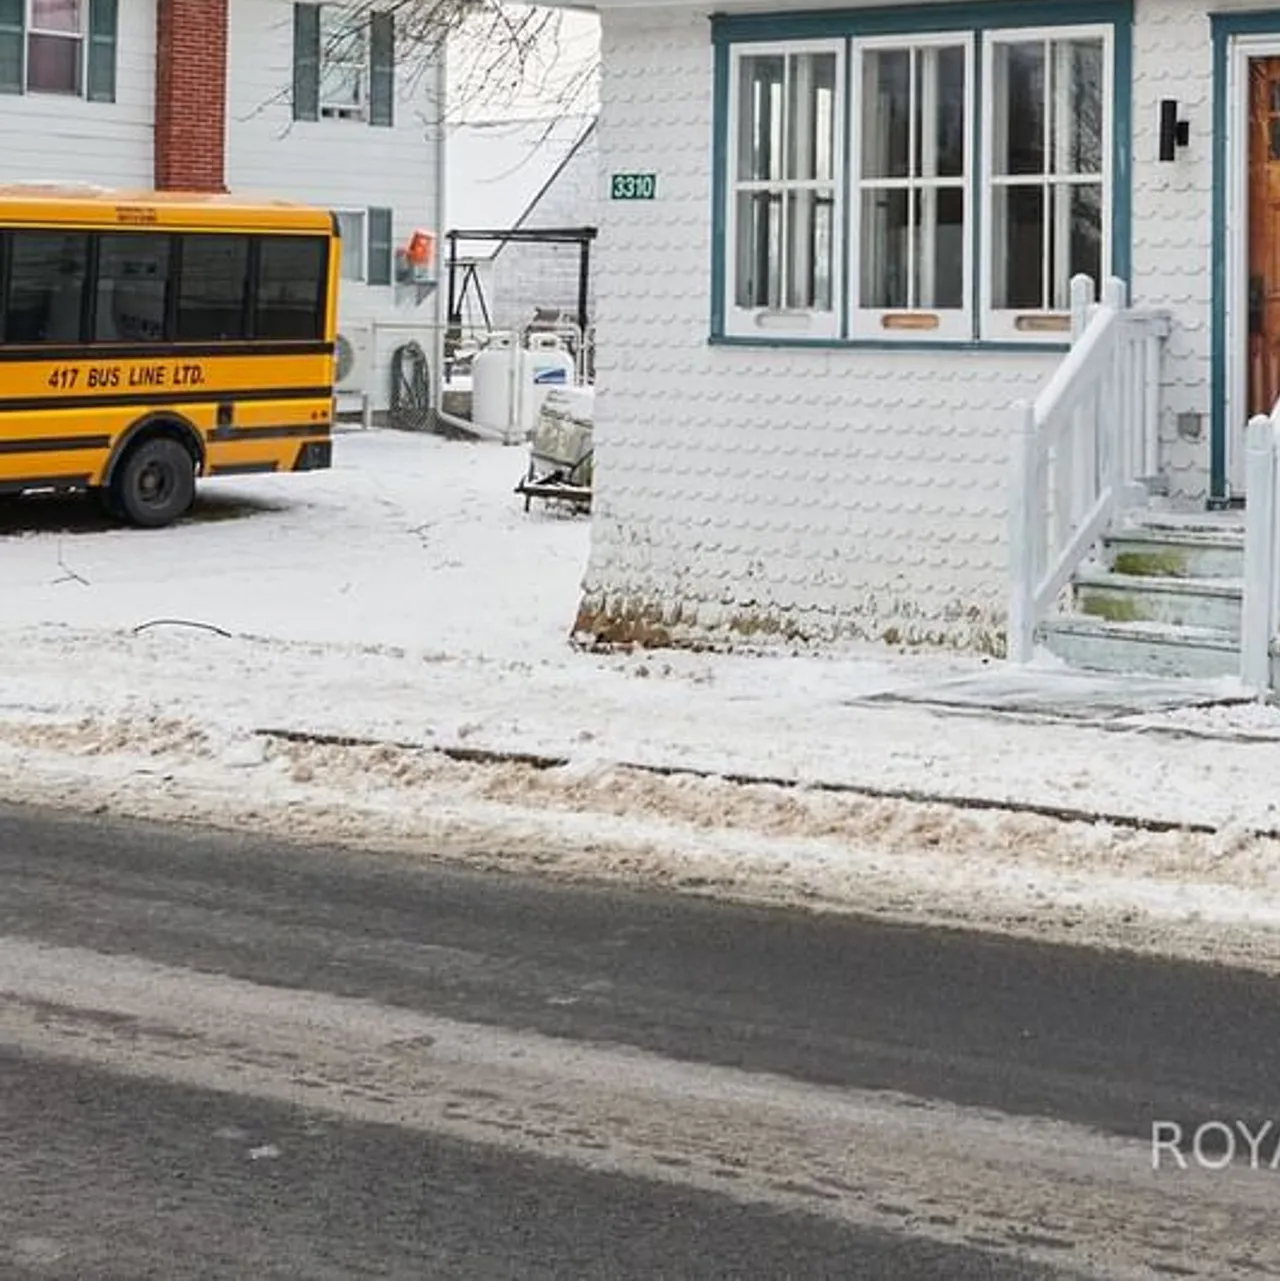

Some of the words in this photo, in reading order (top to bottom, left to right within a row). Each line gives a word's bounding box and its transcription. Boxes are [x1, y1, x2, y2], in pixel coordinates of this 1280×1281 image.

[614, 176, 652, 197] 3310
[48, 367, 78, 389] 417
[87, 366, 121, 388] BUS
[129, 365, 165, 386] LINE
[173, 363, 205, 385] LTD.
